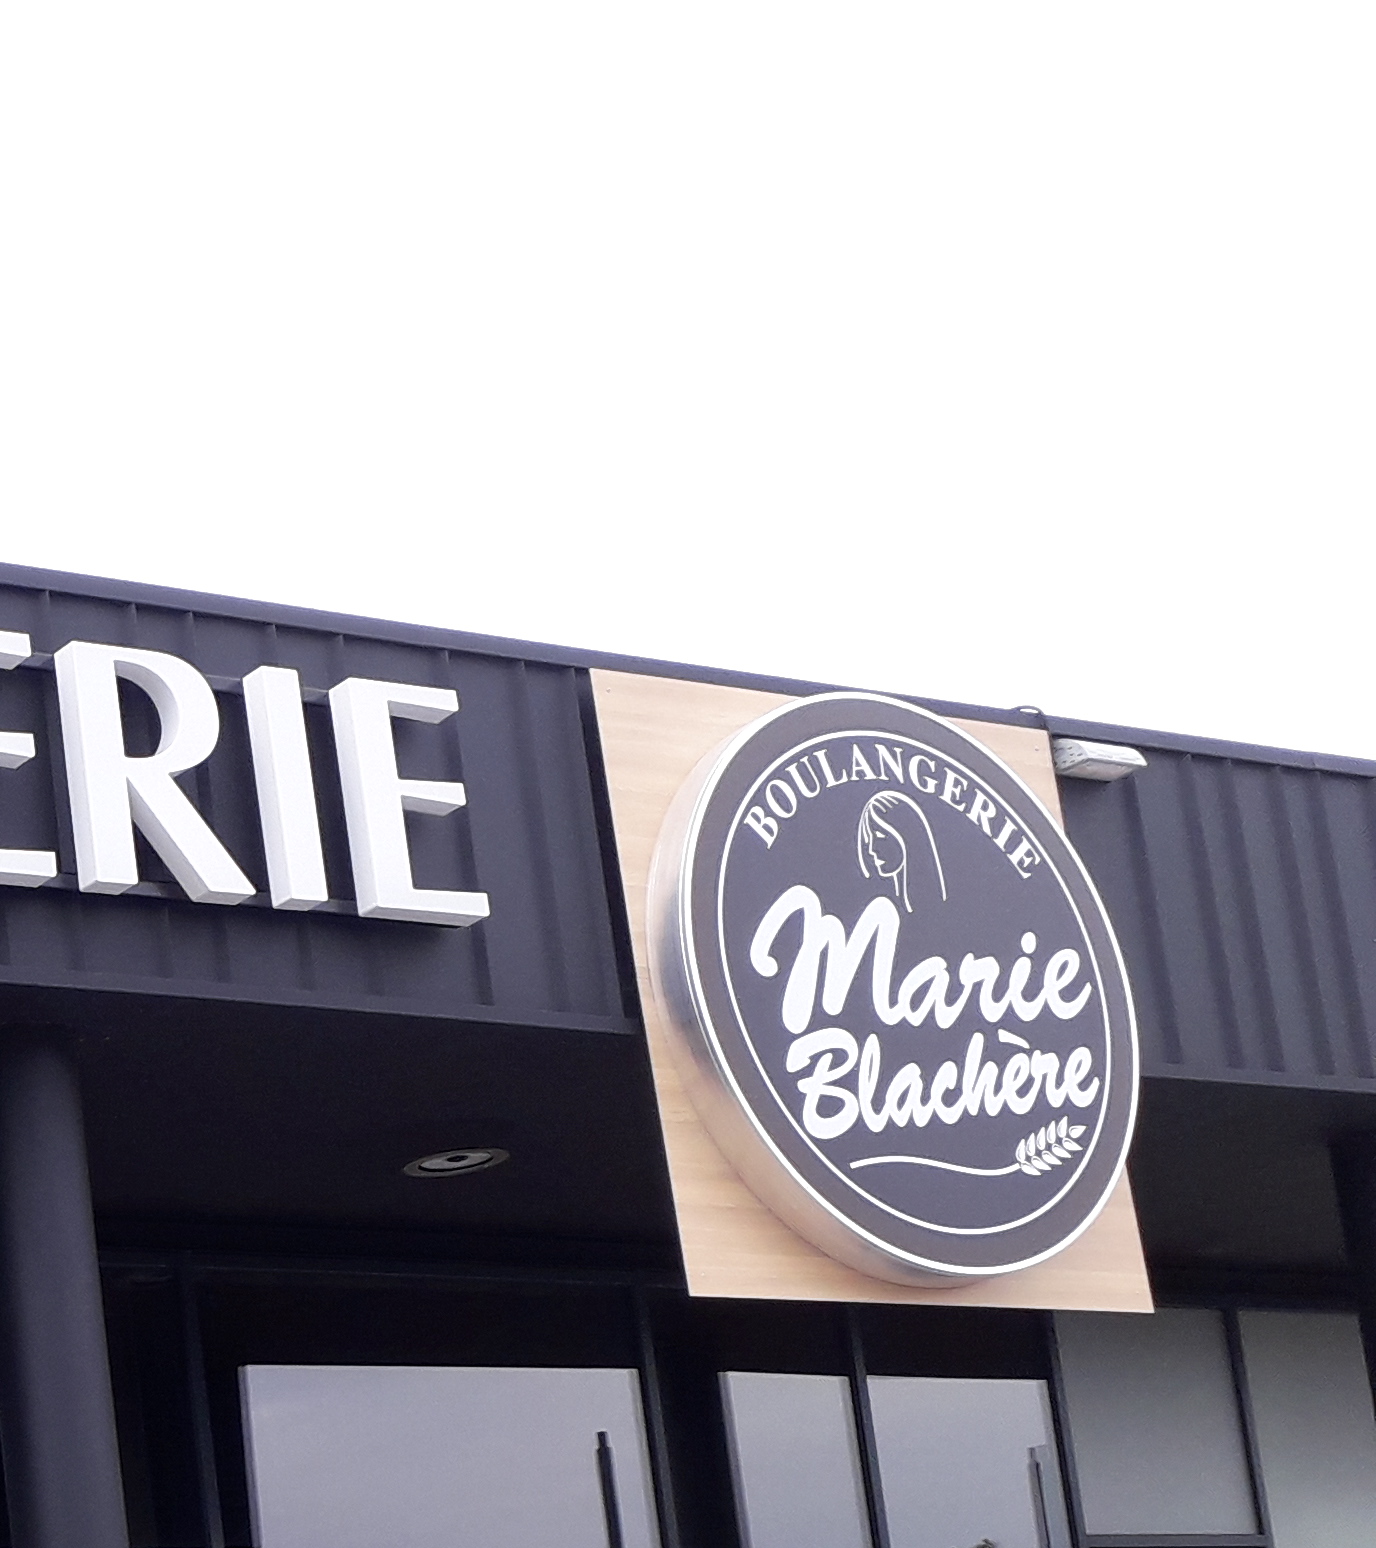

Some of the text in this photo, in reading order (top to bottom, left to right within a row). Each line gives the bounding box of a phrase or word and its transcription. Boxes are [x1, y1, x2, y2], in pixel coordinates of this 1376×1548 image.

[743, 743, 1041, 880] BOULANGERIE
[750, 884, 1091, 1034] Marie
[786, 1027, 1100, 1140] Blachère
